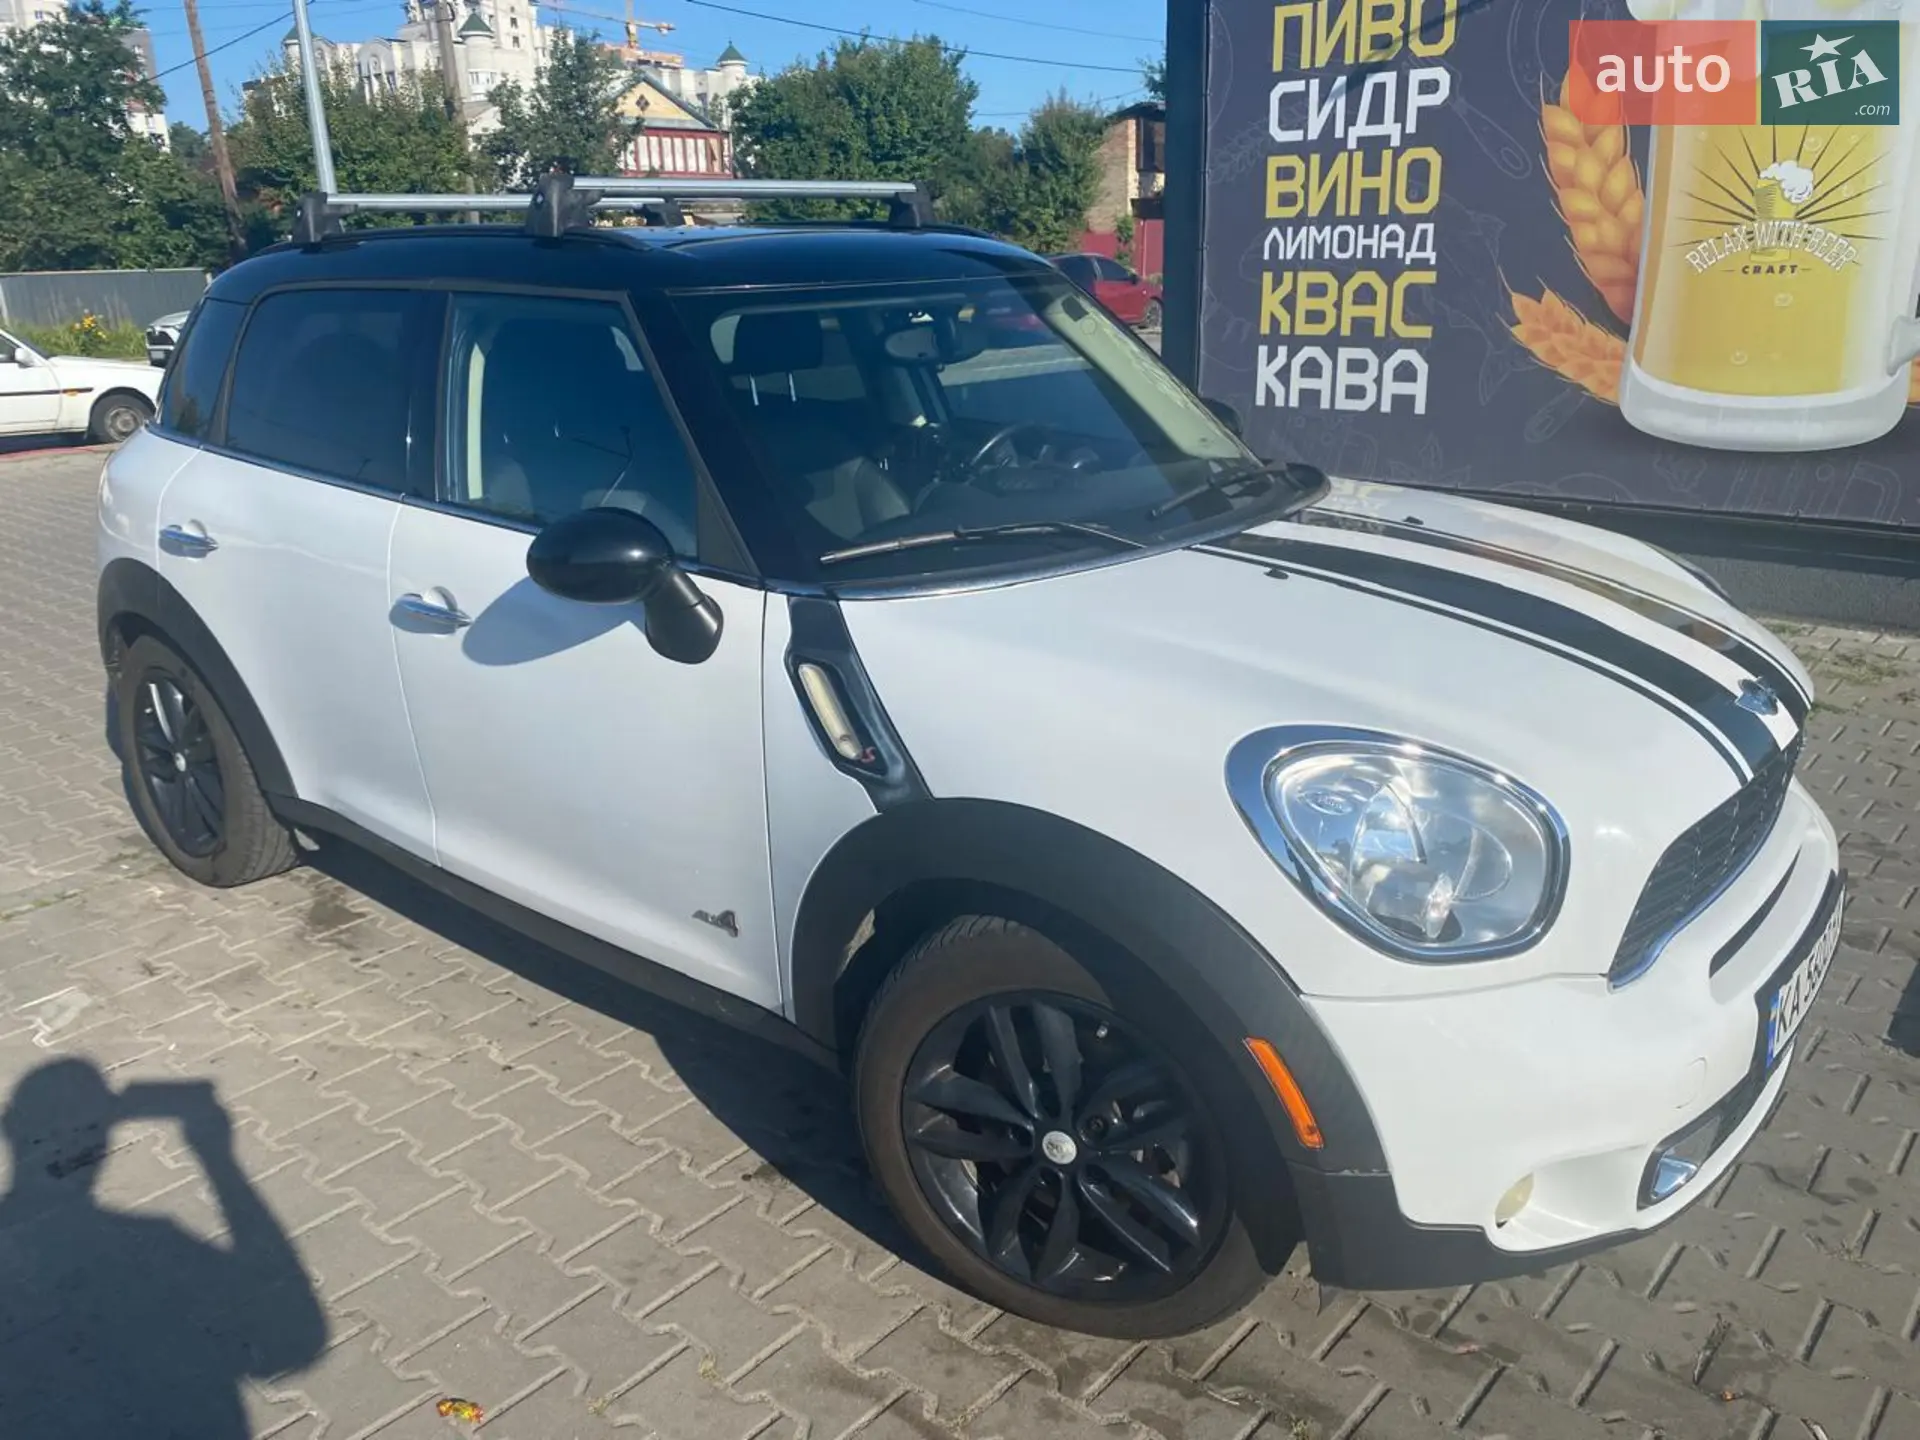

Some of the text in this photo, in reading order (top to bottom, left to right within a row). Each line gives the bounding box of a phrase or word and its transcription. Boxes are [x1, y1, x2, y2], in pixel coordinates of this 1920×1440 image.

[1272, 0, 1457, 72] ПИВО
[1269, 67, 1450, 149] СИДР
[1266, 147, 1442, 218] ВИНО
[1263, 223, 1436, 265] ЛИМОНАД
[1685, 220, 1857, 273] RELAX WITH BEER
[1741, 265, 1798, 274] CRAFT
[1260, 271, 1437, 338] КВАС
[1255, 345, 1429, 414] КАВА
